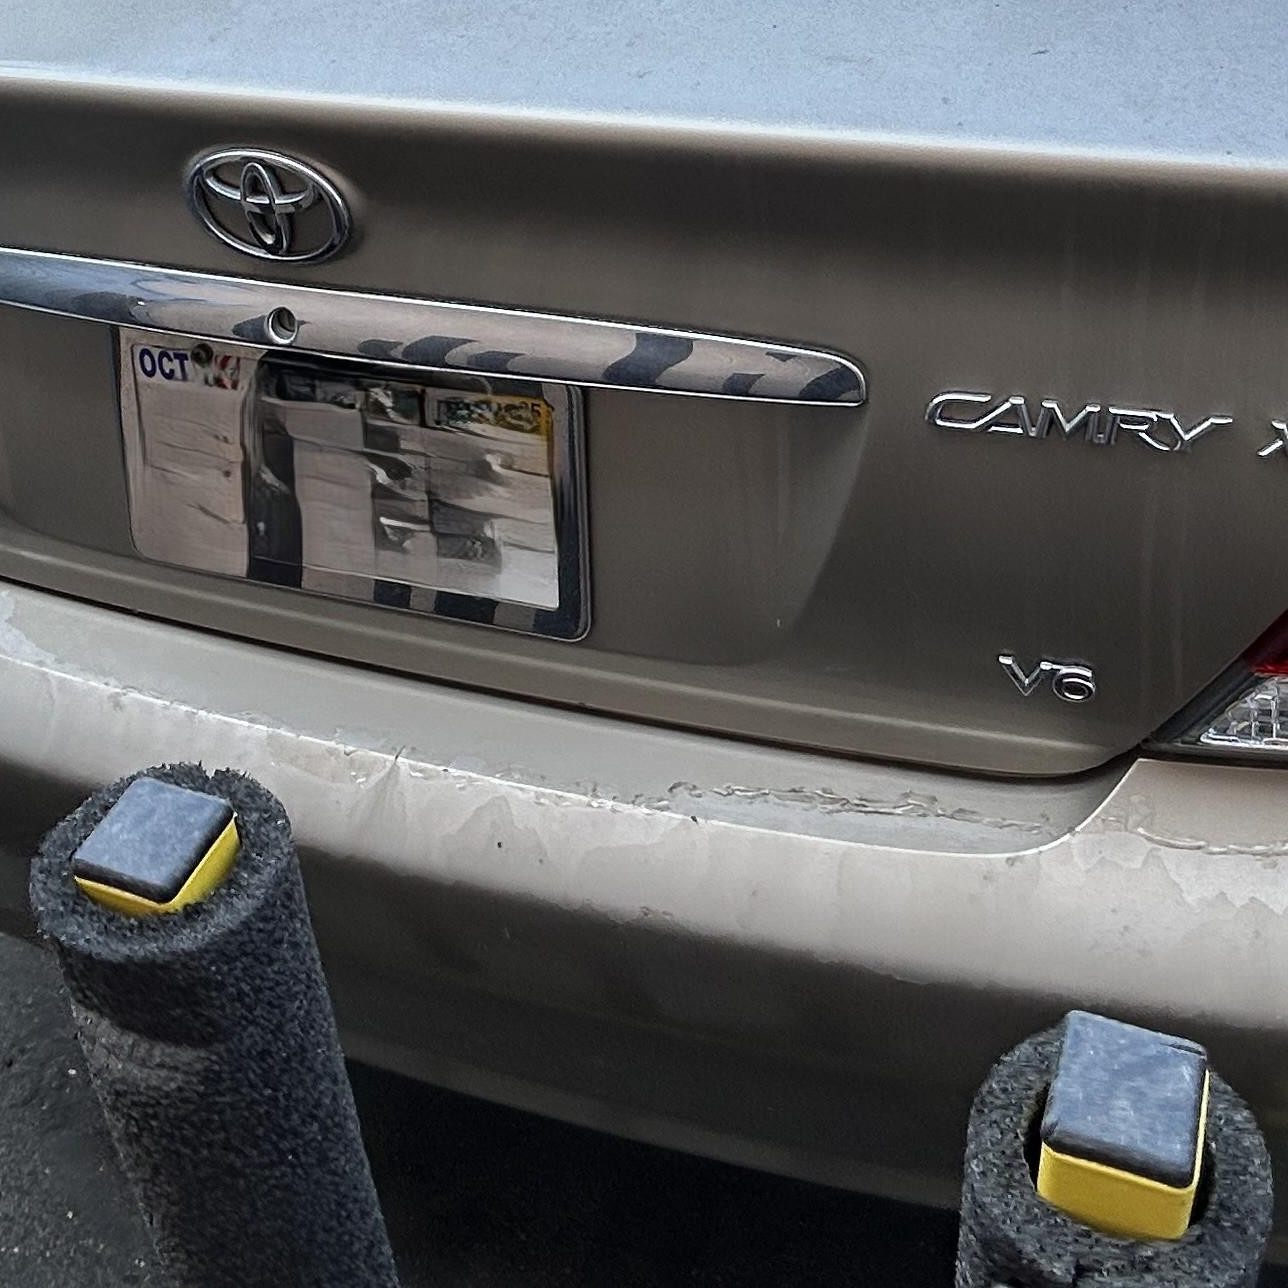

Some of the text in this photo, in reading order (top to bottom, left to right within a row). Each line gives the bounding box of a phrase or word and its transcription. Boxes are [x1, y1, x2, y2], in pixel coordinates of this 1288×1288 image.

[138, 348, 190, 381] OCT
[925, 390, 1233, 452] CAMRY
[998, 654, 1096, 703] V6
